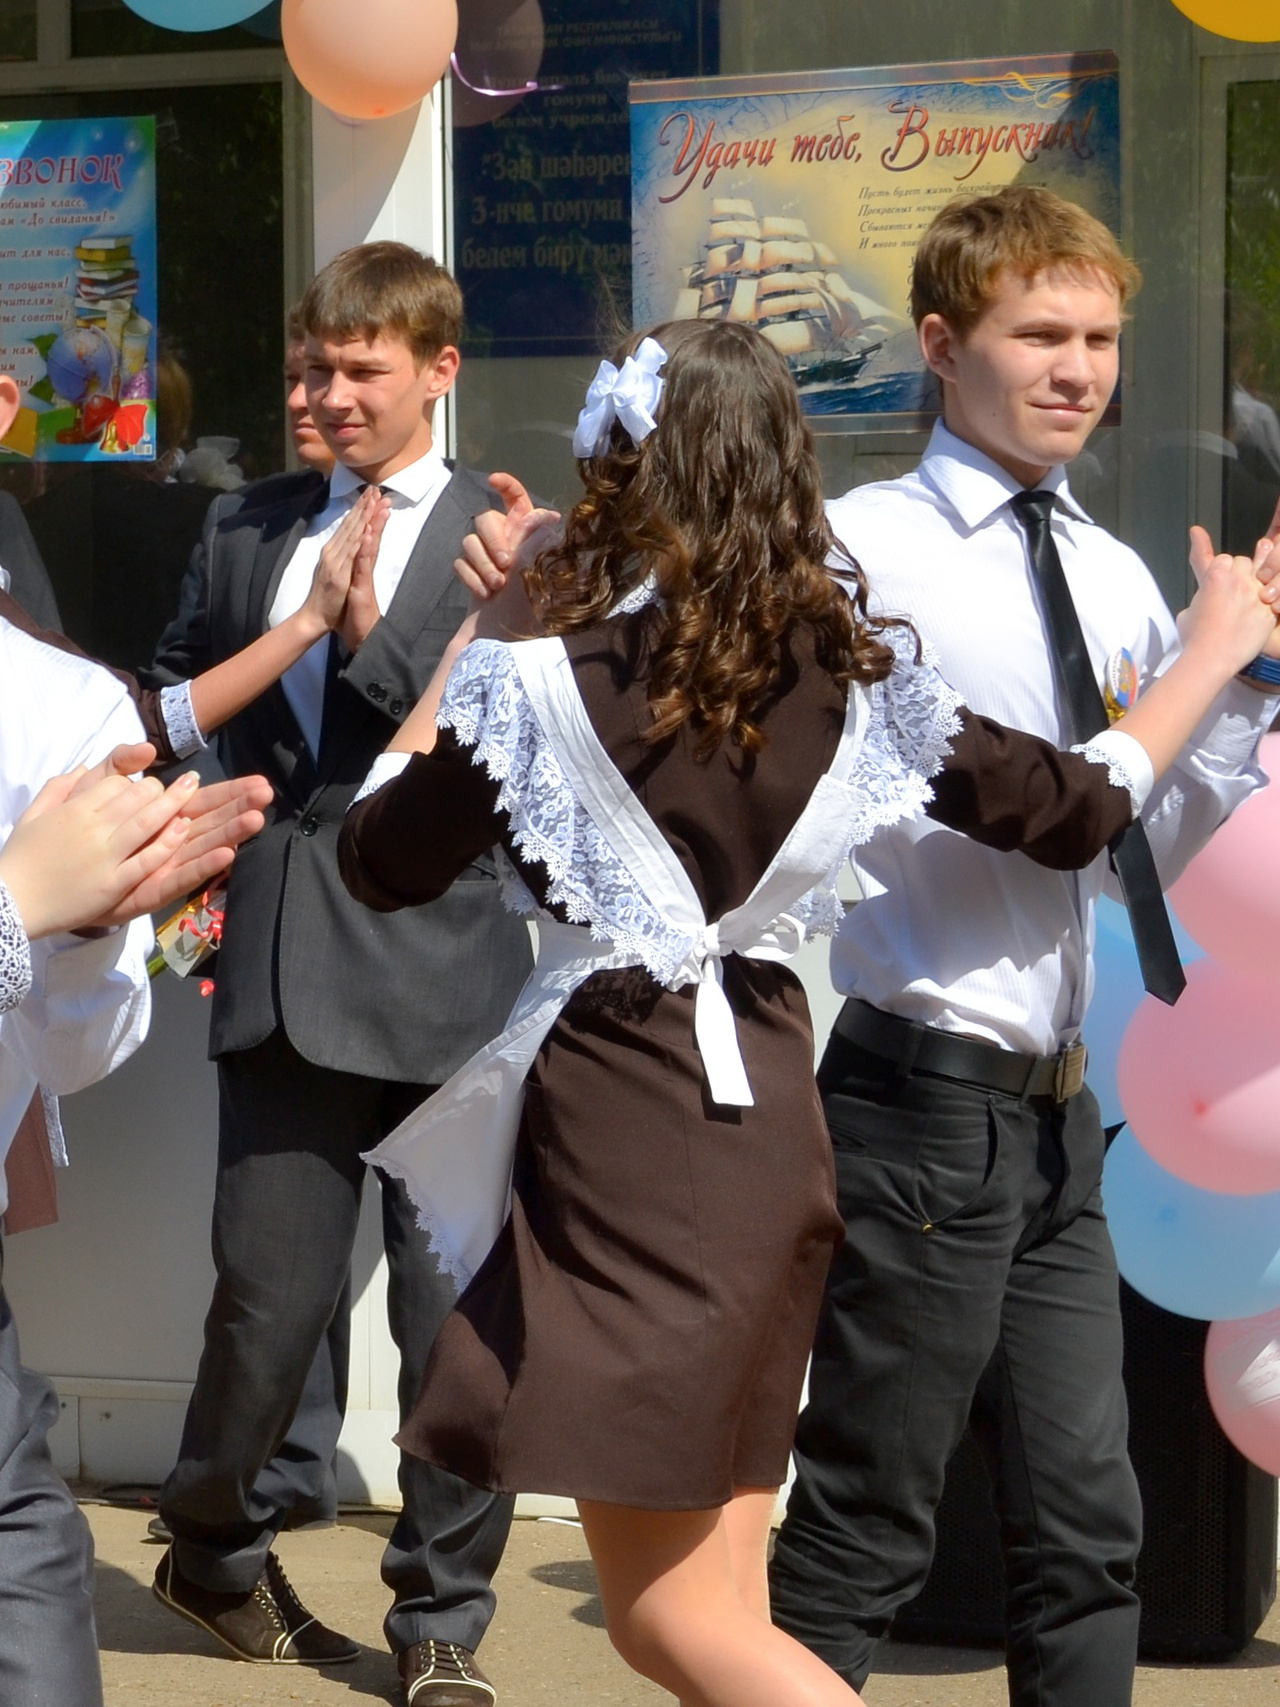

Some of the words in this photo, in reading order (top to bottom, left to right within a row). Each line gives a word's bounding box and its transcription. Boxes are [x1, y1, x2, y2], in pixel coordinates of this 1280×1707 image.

[658, 110, 777, 204] Удачи
[790, 114, 862, 163] тебе,
[880, 100, 1097, 181] Выпускник!
[893, 186, 921, 198] будет
[858, 237, 870, 249] И
[21, 249, 42, 259] для
[8, 276, 69, 293] прощанья!
[21, 310, 69, 322] советы!
